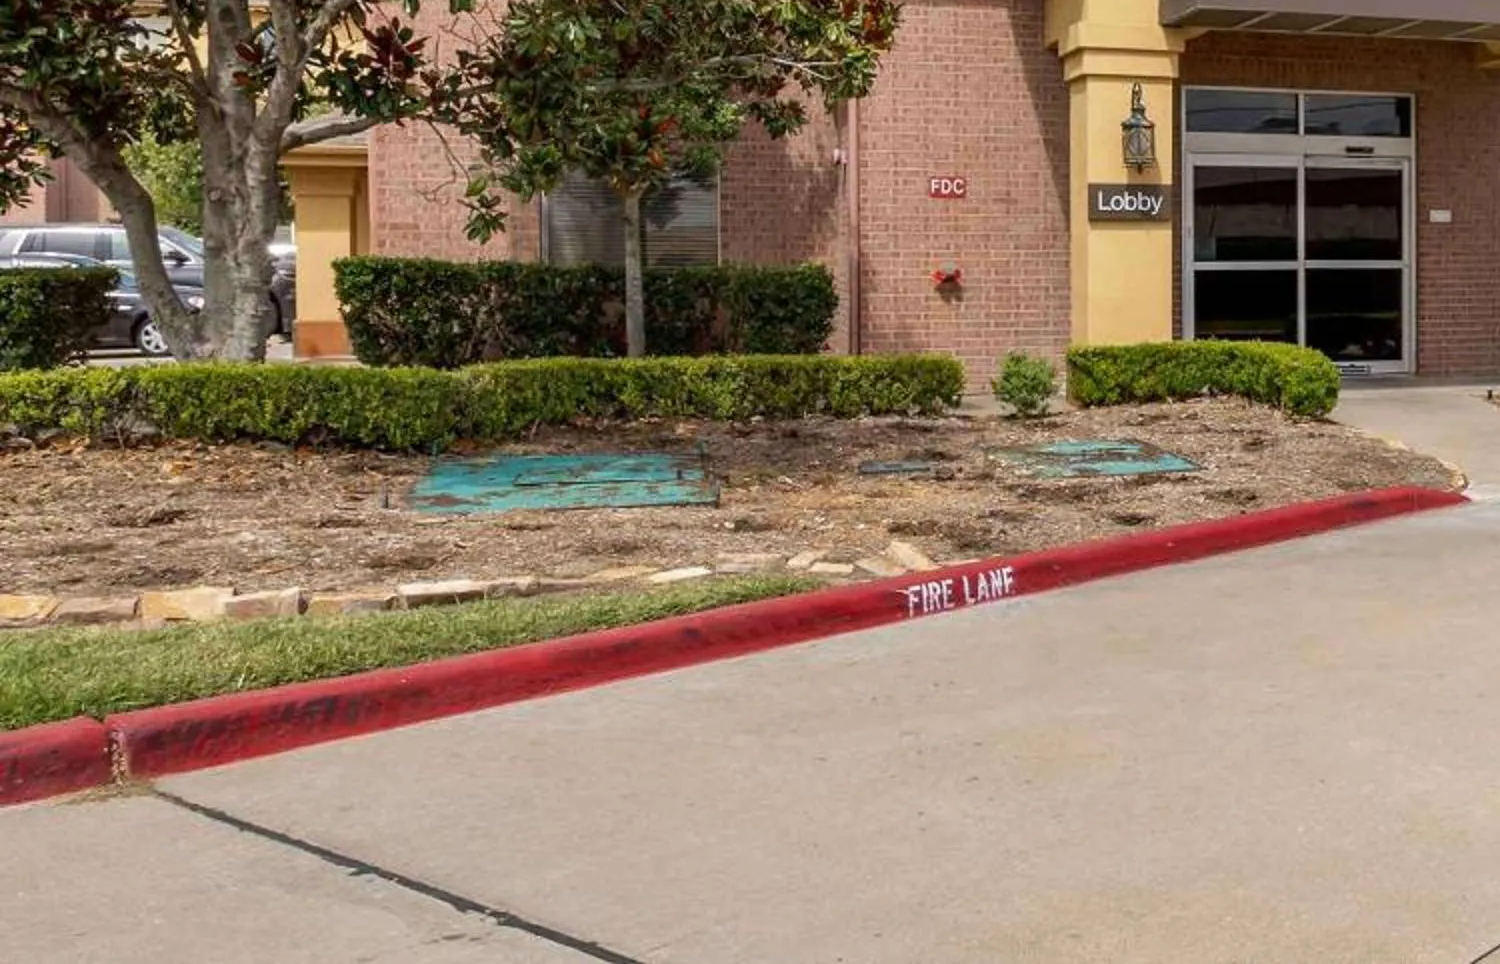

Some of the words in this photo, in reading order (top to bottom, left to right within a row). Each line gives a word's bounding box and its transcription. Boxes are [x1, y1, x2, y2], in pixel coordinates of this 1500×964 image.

[930, 178, 964, 194] FDC
[1096, 191, 1164, 215] Lobby
[906, 578, 955, 618] FIRE
